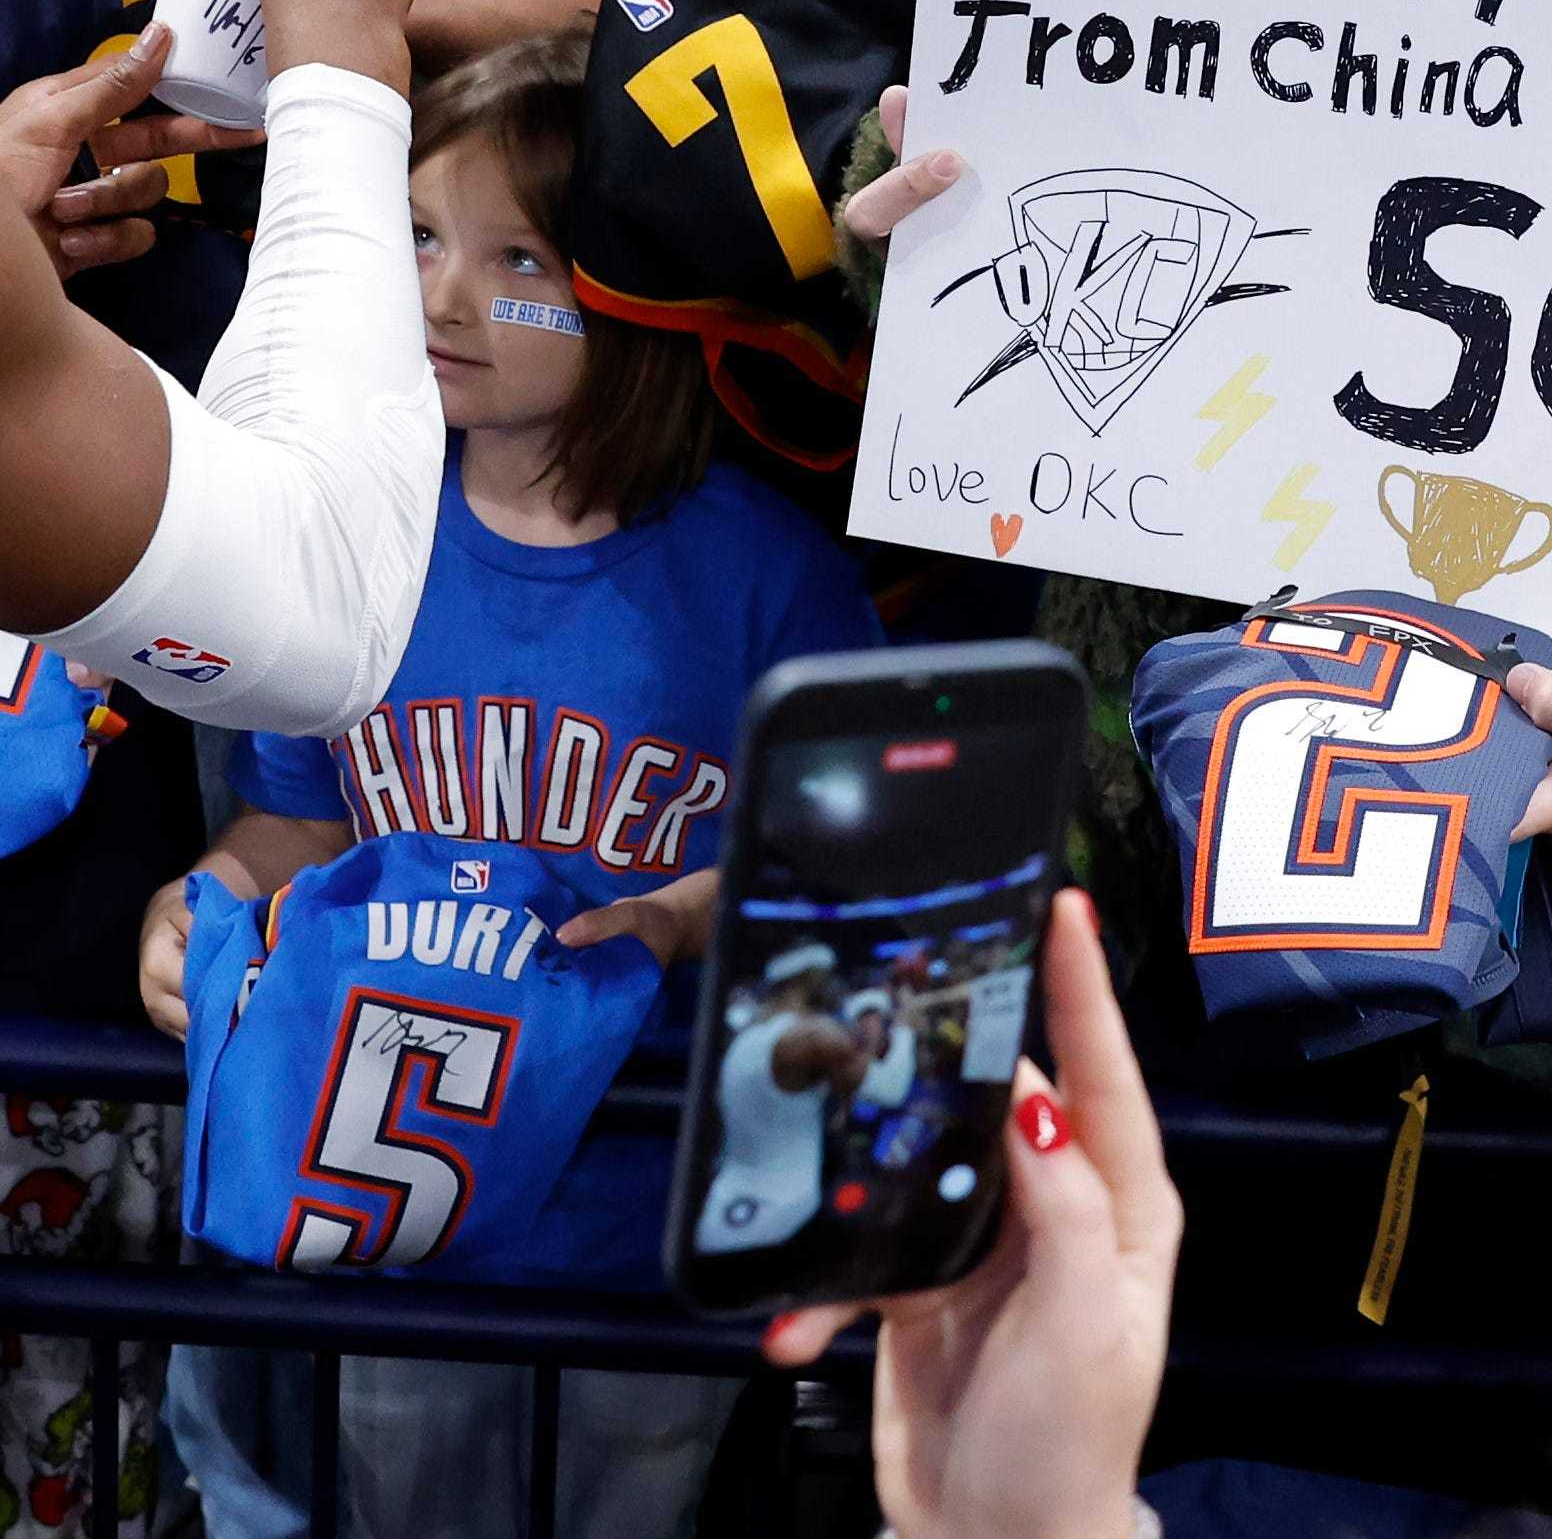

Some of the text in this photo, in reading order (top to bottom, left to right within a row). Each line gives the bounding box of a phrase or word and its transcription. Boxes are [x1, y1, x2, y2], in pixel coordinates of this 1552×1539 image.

[624, 13, 836, 281] 7
[493, 299, 586, 335] WE ARE THUN
[1028, 452, 1184, 537] OKC
[332, 696, 733, 875] HUNDER
[1188, 603, 1502, 955] 2
[275, 985, 523, 1272] 5
